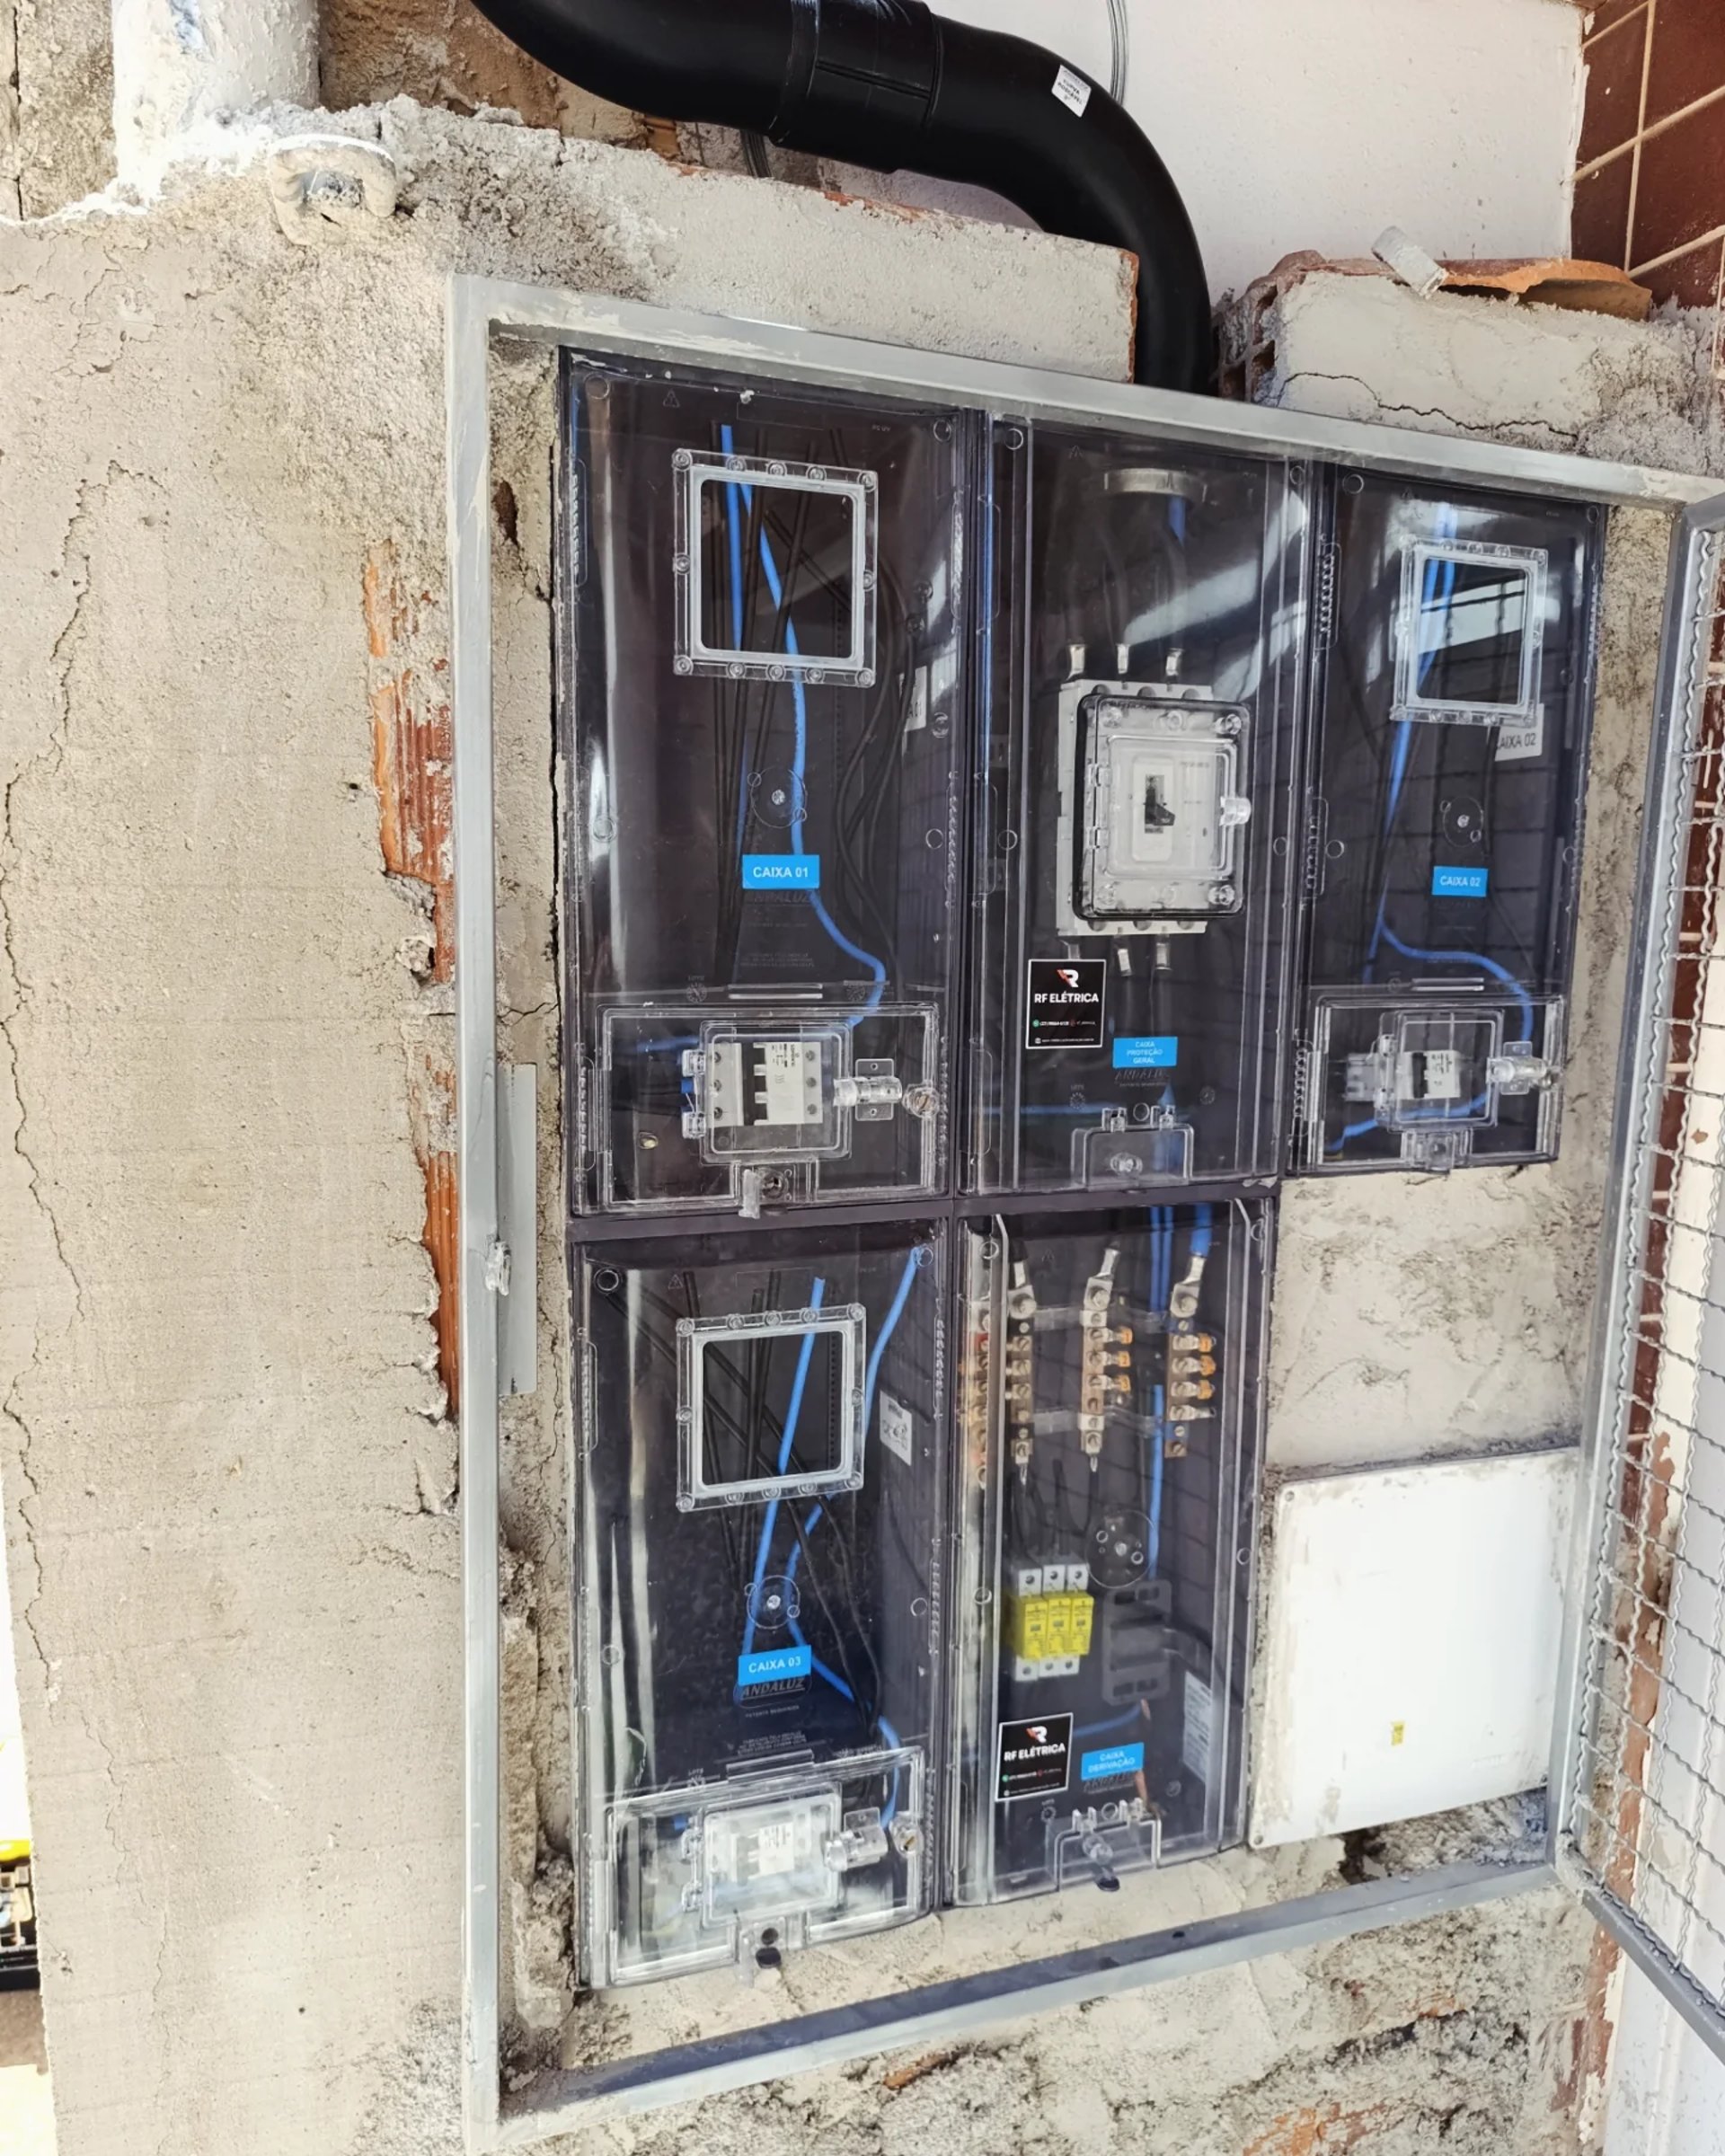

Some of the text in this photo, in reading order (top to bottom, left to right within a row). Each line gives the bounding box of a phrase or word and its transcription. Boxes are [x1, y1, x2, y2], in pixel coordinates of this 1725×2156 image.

[1498, 732, 1536, 749] AIXA 02
[753, 867, 809, 878] CAIXA 01
[1440, 875, 1481, 888] CAIXA 02
[1034, 990, 1099, 1003] RF ELÉTRICA
[1133, 1056, 1155, 1065] GERAL
[748, 1656, 801, 1674] CAIXA 03
[1004, 1743, 1066, 1761] RF ELÉTRICA
[1099, 1750, 1125, 1763] CAIXA
